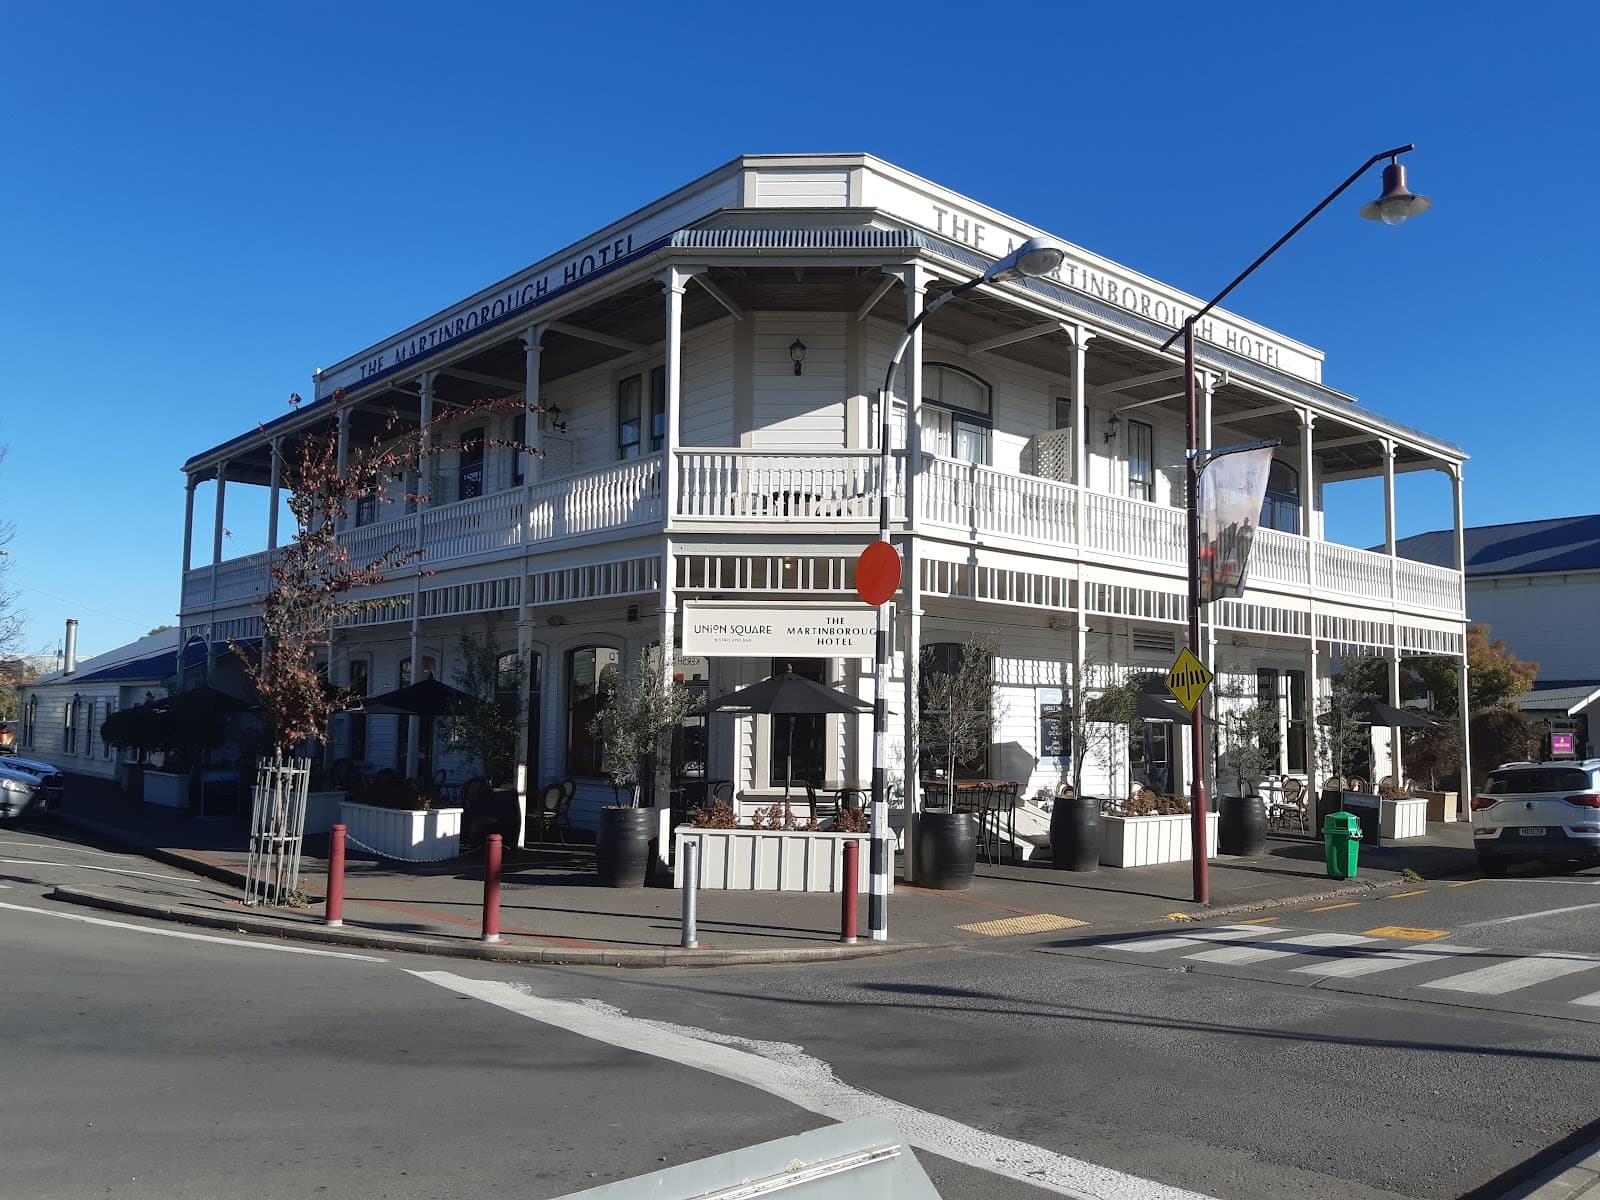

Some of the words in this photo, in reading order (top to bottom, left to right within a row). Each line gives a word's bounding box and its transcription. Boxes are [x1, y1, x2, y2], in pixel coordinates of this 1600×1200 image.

[932, 205, 986, 249] THE
[1007, 237, 1213, 341] RTINBOROUH
[1226, 328, 1279, 368] HOTEL
[359, 355, 385, 379] THE
[394, 275, 549, 364] MARTINBOROUGH
[563, 233, 633, 285] HOTEL
[826, 617, 846, 625] THE
[730, 624, 773, 637] SQUARE
[786, 627, 877, 636] MARTINBOROUG
[817, 637, 853, 646] HOTEL
